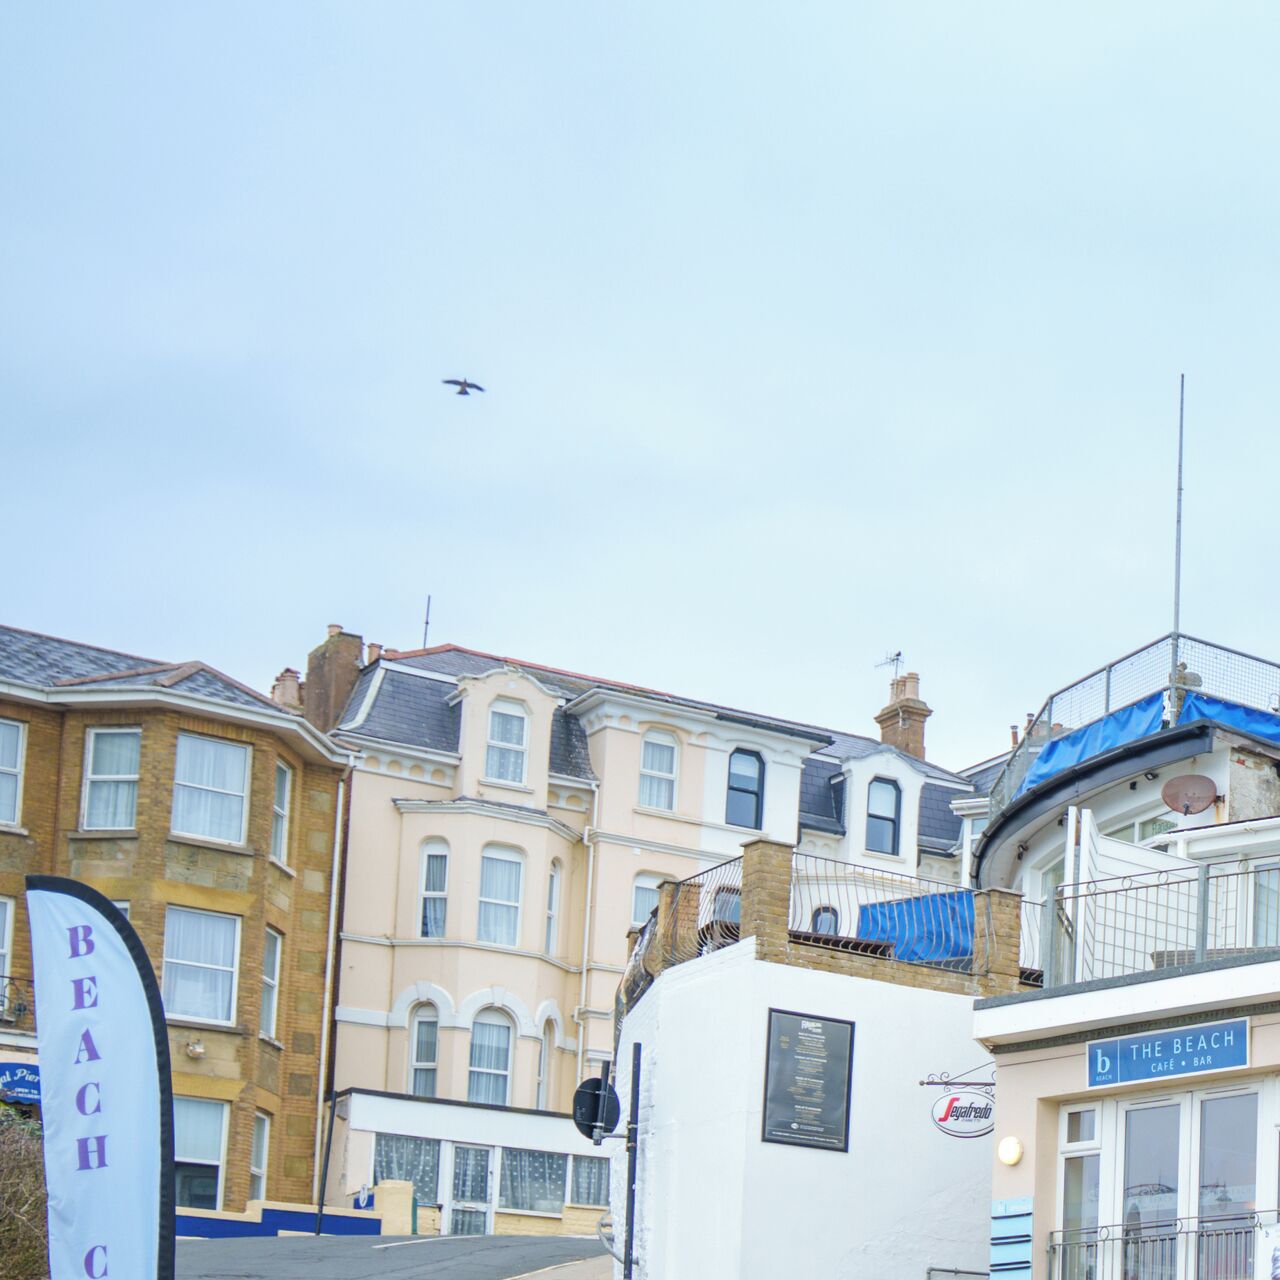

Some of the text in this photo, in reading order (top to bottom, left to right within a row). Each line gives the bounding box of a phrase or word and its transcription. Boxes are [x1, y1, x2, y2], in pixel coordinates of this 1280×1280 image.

[68, 924, 108, 1171] BEACH
[1130, 1030, 1234, 1061] THE BEACH
[1096, 1049, 1111, 1074] b
[1151, 1056, 1212, 1073] CAFÉ BAR
[938, 1097, 993, 1122] Segafredo
